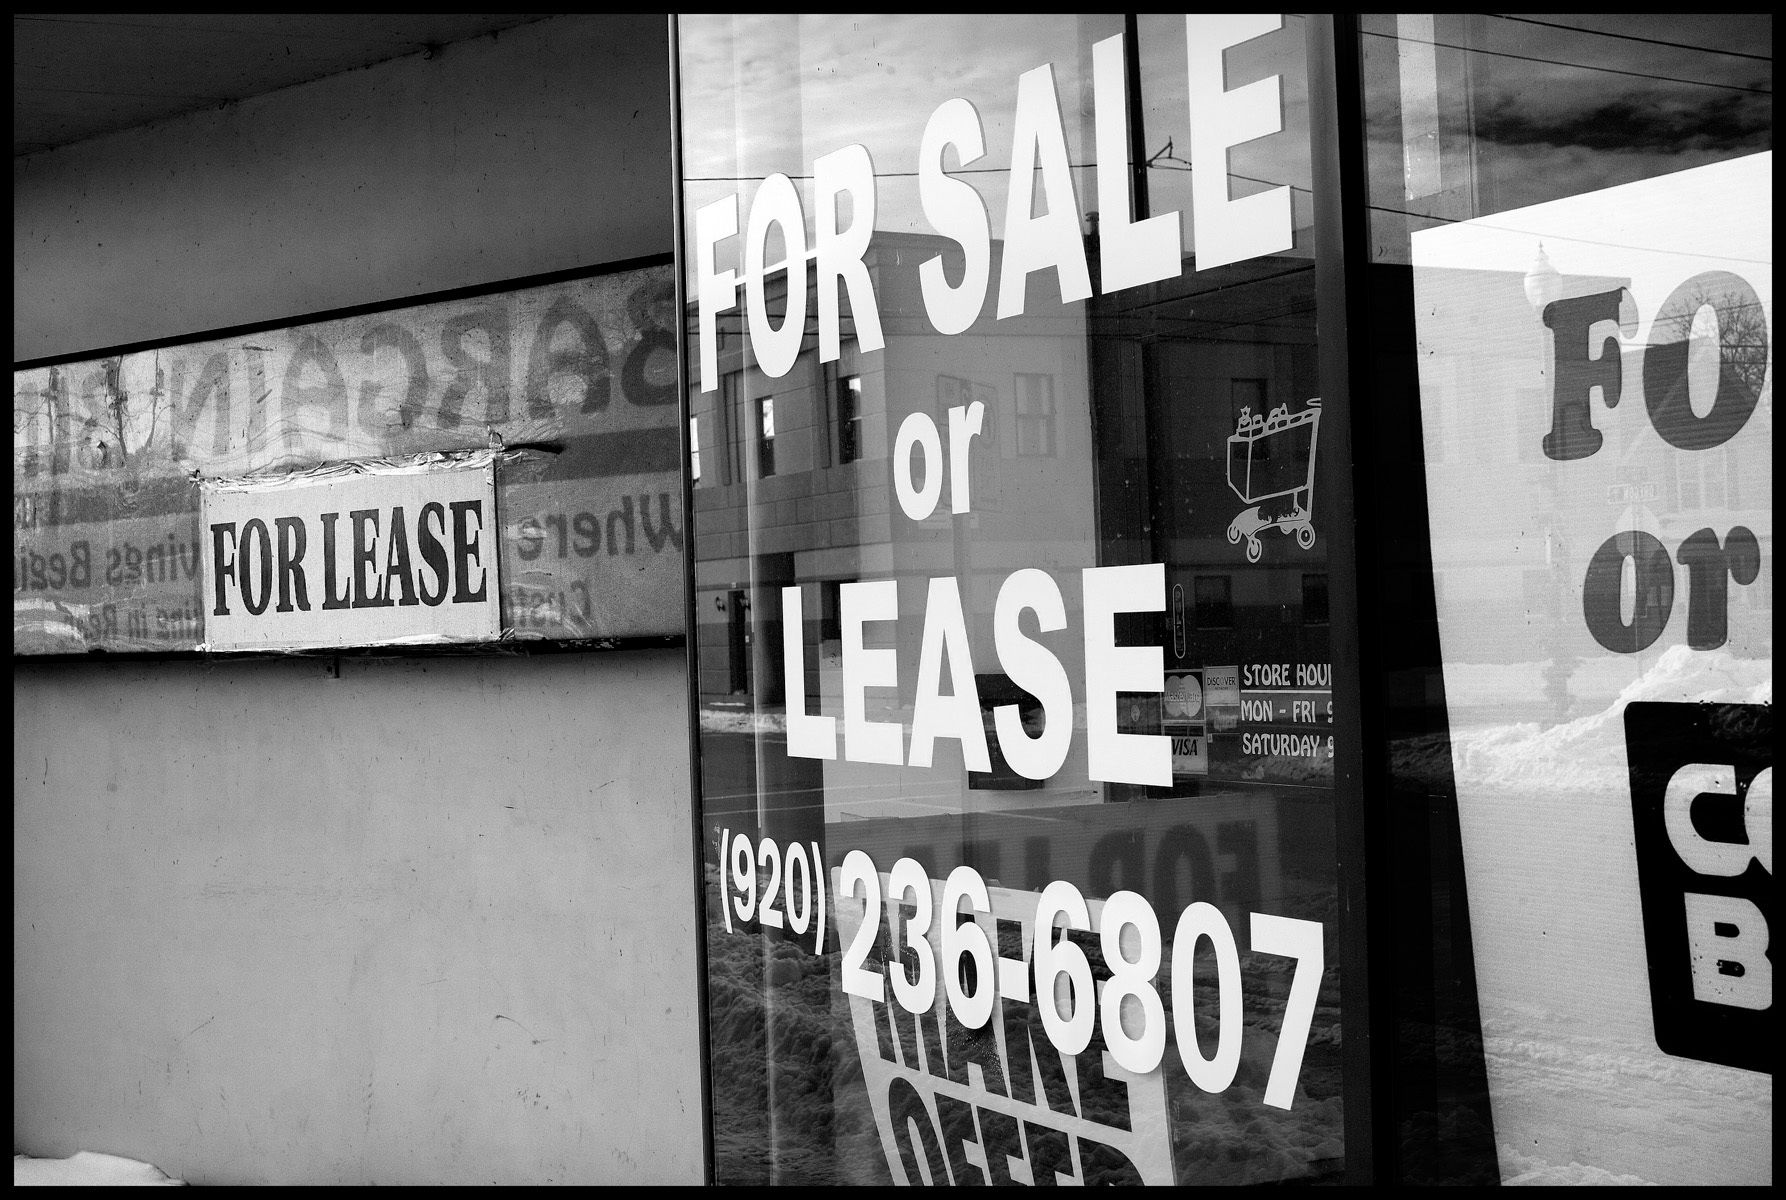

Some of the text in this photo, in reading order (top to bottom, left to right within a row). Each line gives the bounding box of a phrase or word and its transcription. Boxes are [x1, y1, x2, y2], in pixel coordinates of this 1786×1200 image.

[697, 14, 1294, 393] FOR SALE
[894, 401, 985, 521] or
[210, 500, 488, 617] FOR LEASE
[1583, 525, 1761, 654] or
[782, 563, 1173, 788] LEASE
[1241, 700, 1273, 722] MON
[1293, 700, 1316, 723] FRI
[1243, 664, 1290, 686] STORE
[1171, 738, 1198, 756] VISA
[1242, 732, 1320, 757] SATURDAY
[720, 827, 1325, 1112] (920) 236-6807
